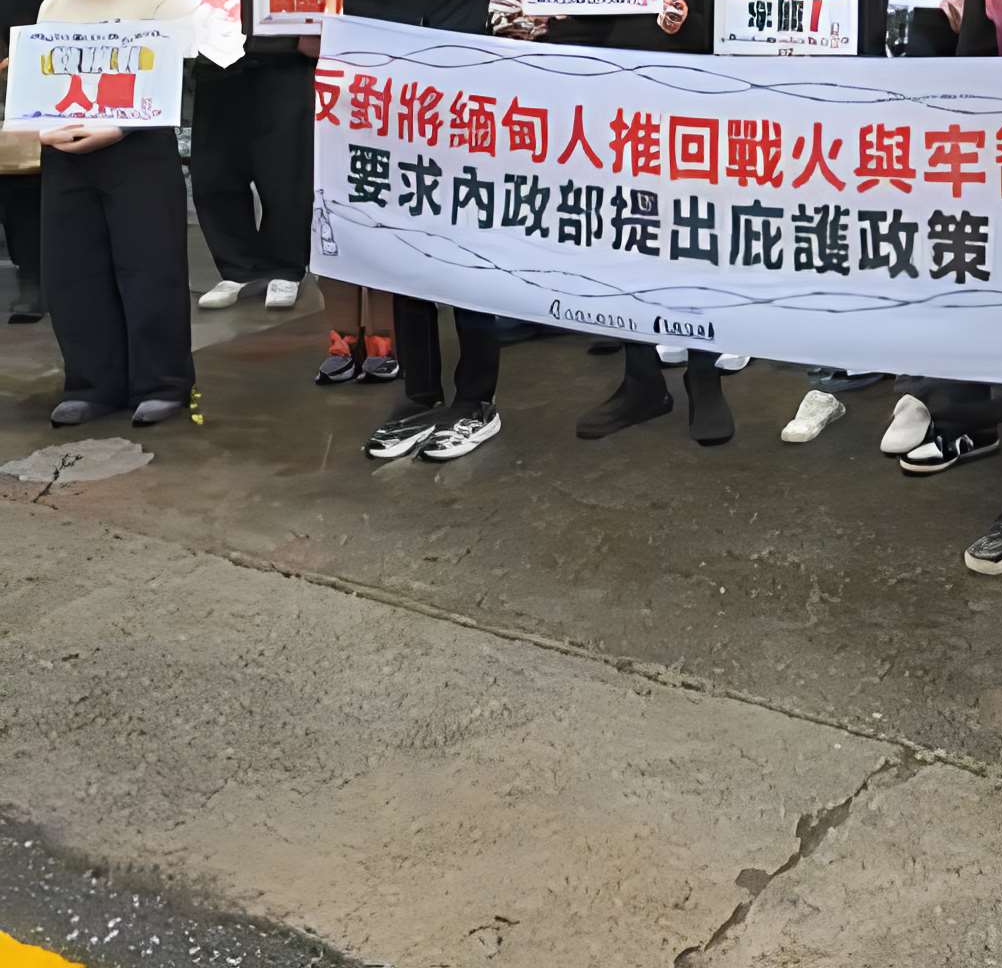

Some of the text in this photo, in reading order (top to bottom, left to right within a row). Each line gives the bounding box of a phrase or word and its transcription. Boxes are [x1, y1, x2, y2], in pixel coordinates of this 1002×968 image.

[347, 144, 991, 284] 要求內政部提出庇護政策
